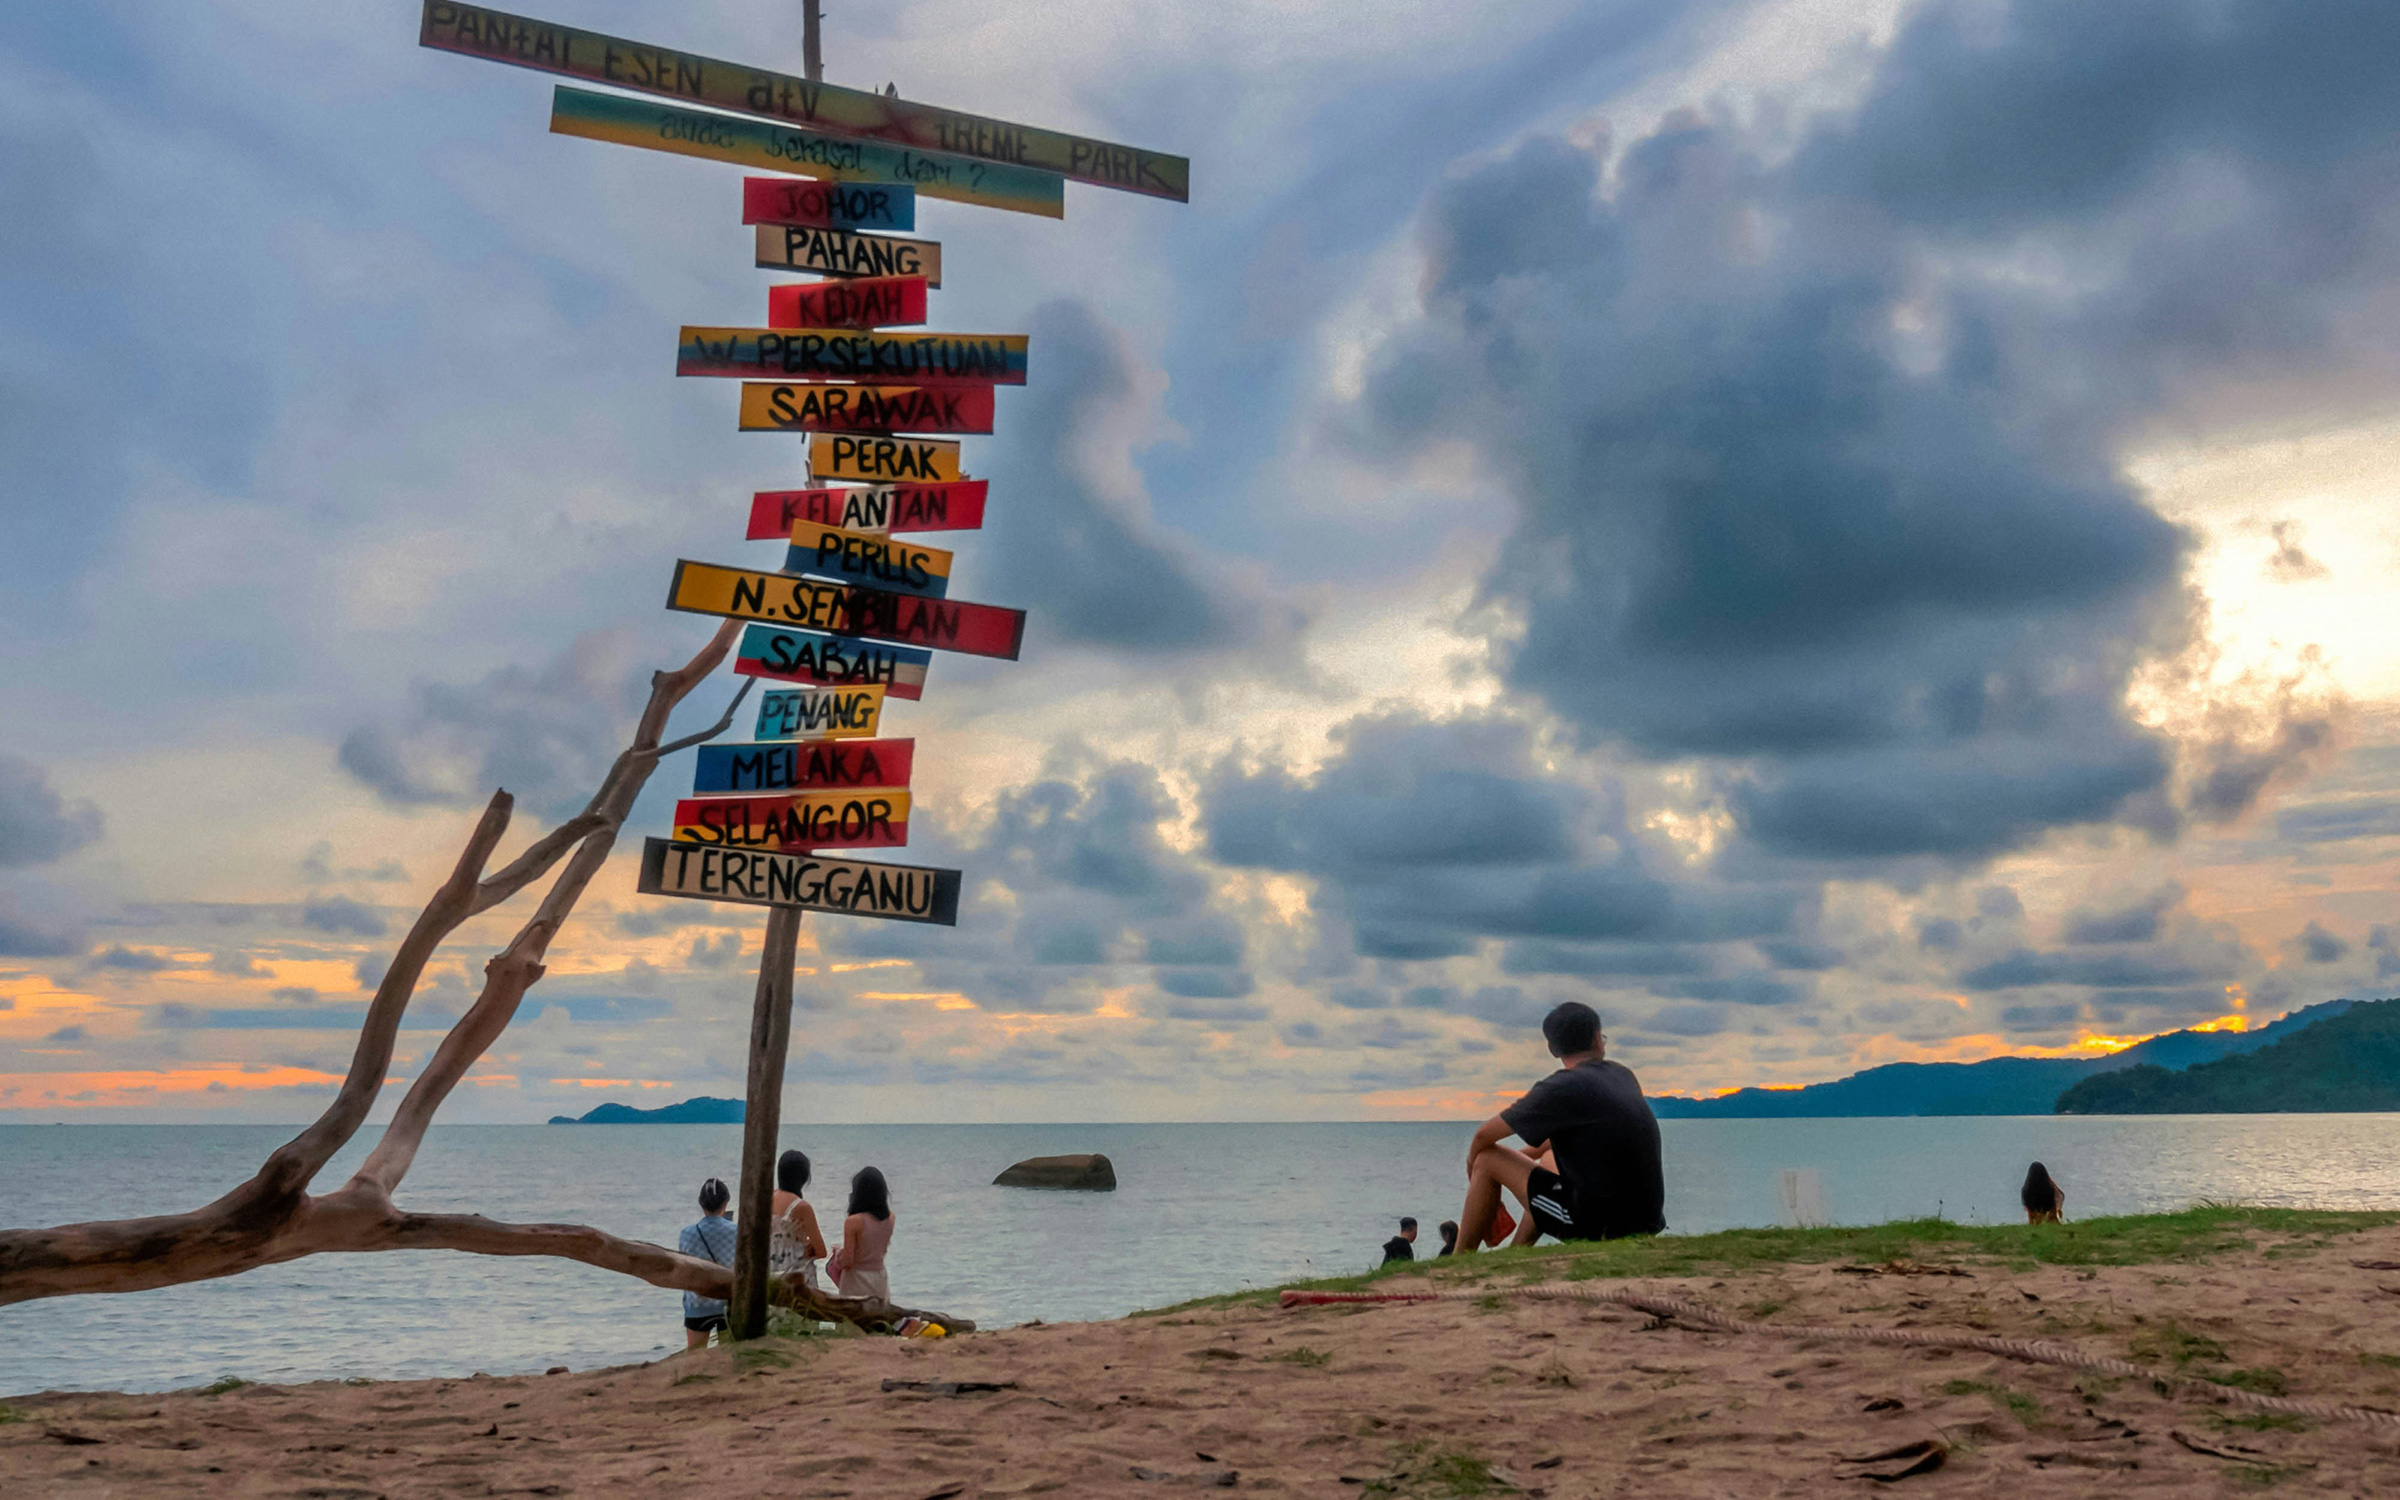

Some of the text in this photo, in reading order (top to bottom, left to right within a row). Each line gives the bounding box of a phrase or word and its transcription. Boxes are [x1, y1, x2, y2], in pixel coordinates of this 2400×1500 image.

[603, 43, 704, 97] ESEN
[1070, 140, 1170, 197] PARK
[765, 129, 868, 174] berasal
[895, 150, 952, 184] dari
[780, 182, 893, 223] JOHOR
[785, 226, 922, 276] PAHANG
[800, 284, 903, 327] KEDAH
[696, 334, 1007, 377] W PERSEKUTUAN
[767, 386, 968, 428] SARAWAK
[832, 436, 940, 481] PERAK
[781, 487, 948, 532] KELANTAN
[817, 532, 930, 589] PERLIS
[760, 635, 897, 686] SABAH
[760, 692, 876, 735] PENANG
[731, 745, 883, 791] MELAKA
[682, 799, 897, 846] SELANGOR
[670, 843, 931, 915] TERENGGANU
